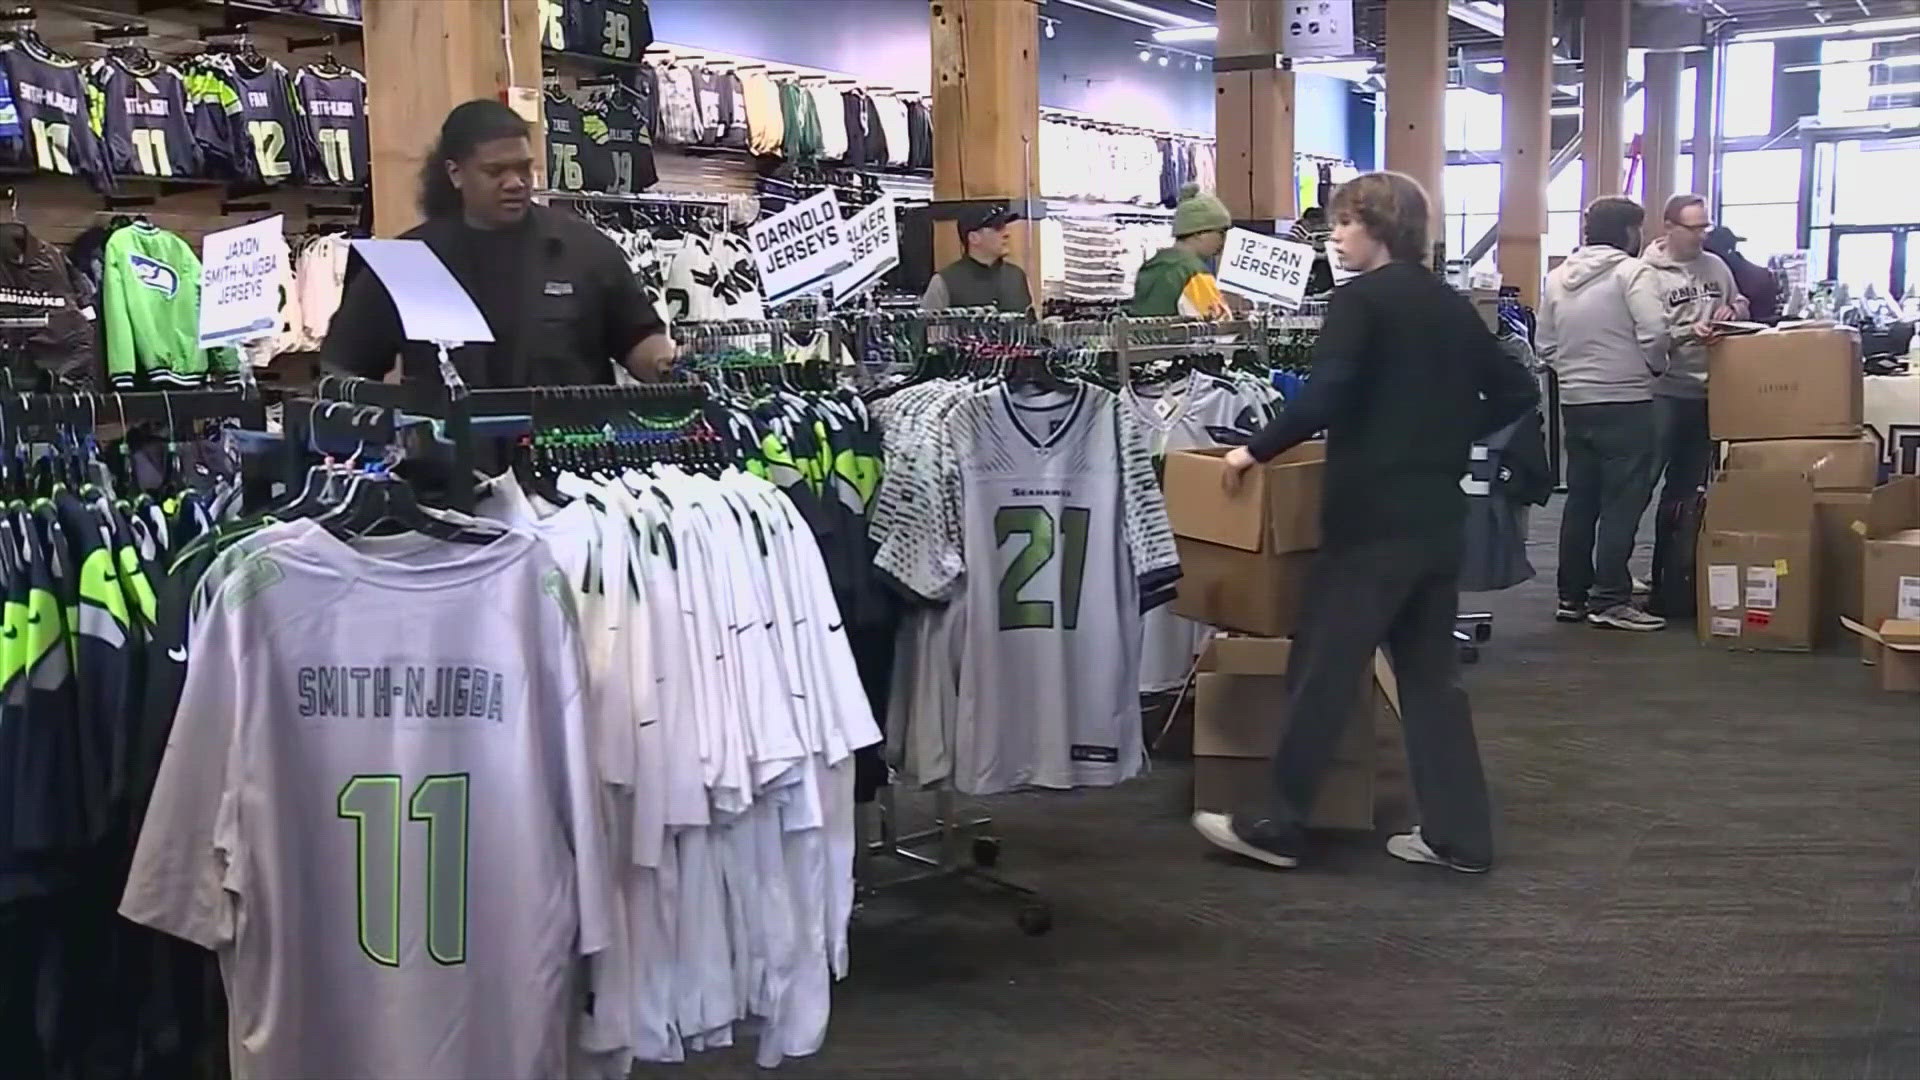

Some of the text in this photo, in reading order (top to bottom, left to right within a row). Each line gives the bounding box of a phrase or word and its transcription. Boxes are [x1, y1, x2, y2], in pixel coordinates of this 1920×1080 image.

[602, 10, 632, 58] 39
[248, 92, 268, 107] FAN
[132, 128, 173, 177] 11
[248, 121, 291, 176] 12
[319, 128, 354, 181] 11
[551, 143, 584, 190] 76
[225, 237, 259, 260] JAXON
[756, 201, 835, 252] DARNOLD
[846, 206, 887, 244] ALKER
[205, 254, 277, 287] SMITH-NJIGBA
[766, 225, 840, 274] JERSEYS
[1230, 254, 1301, 286] JERSEYS
[1269, 247, 1303, 268] FAN
[218, 279, 262, 305] JERSEYS
[994, 506, 1090, 632] 21
[298, 666, 504, 723] SMITH-NJIGBA
[337, 772, 470, 967] 11
